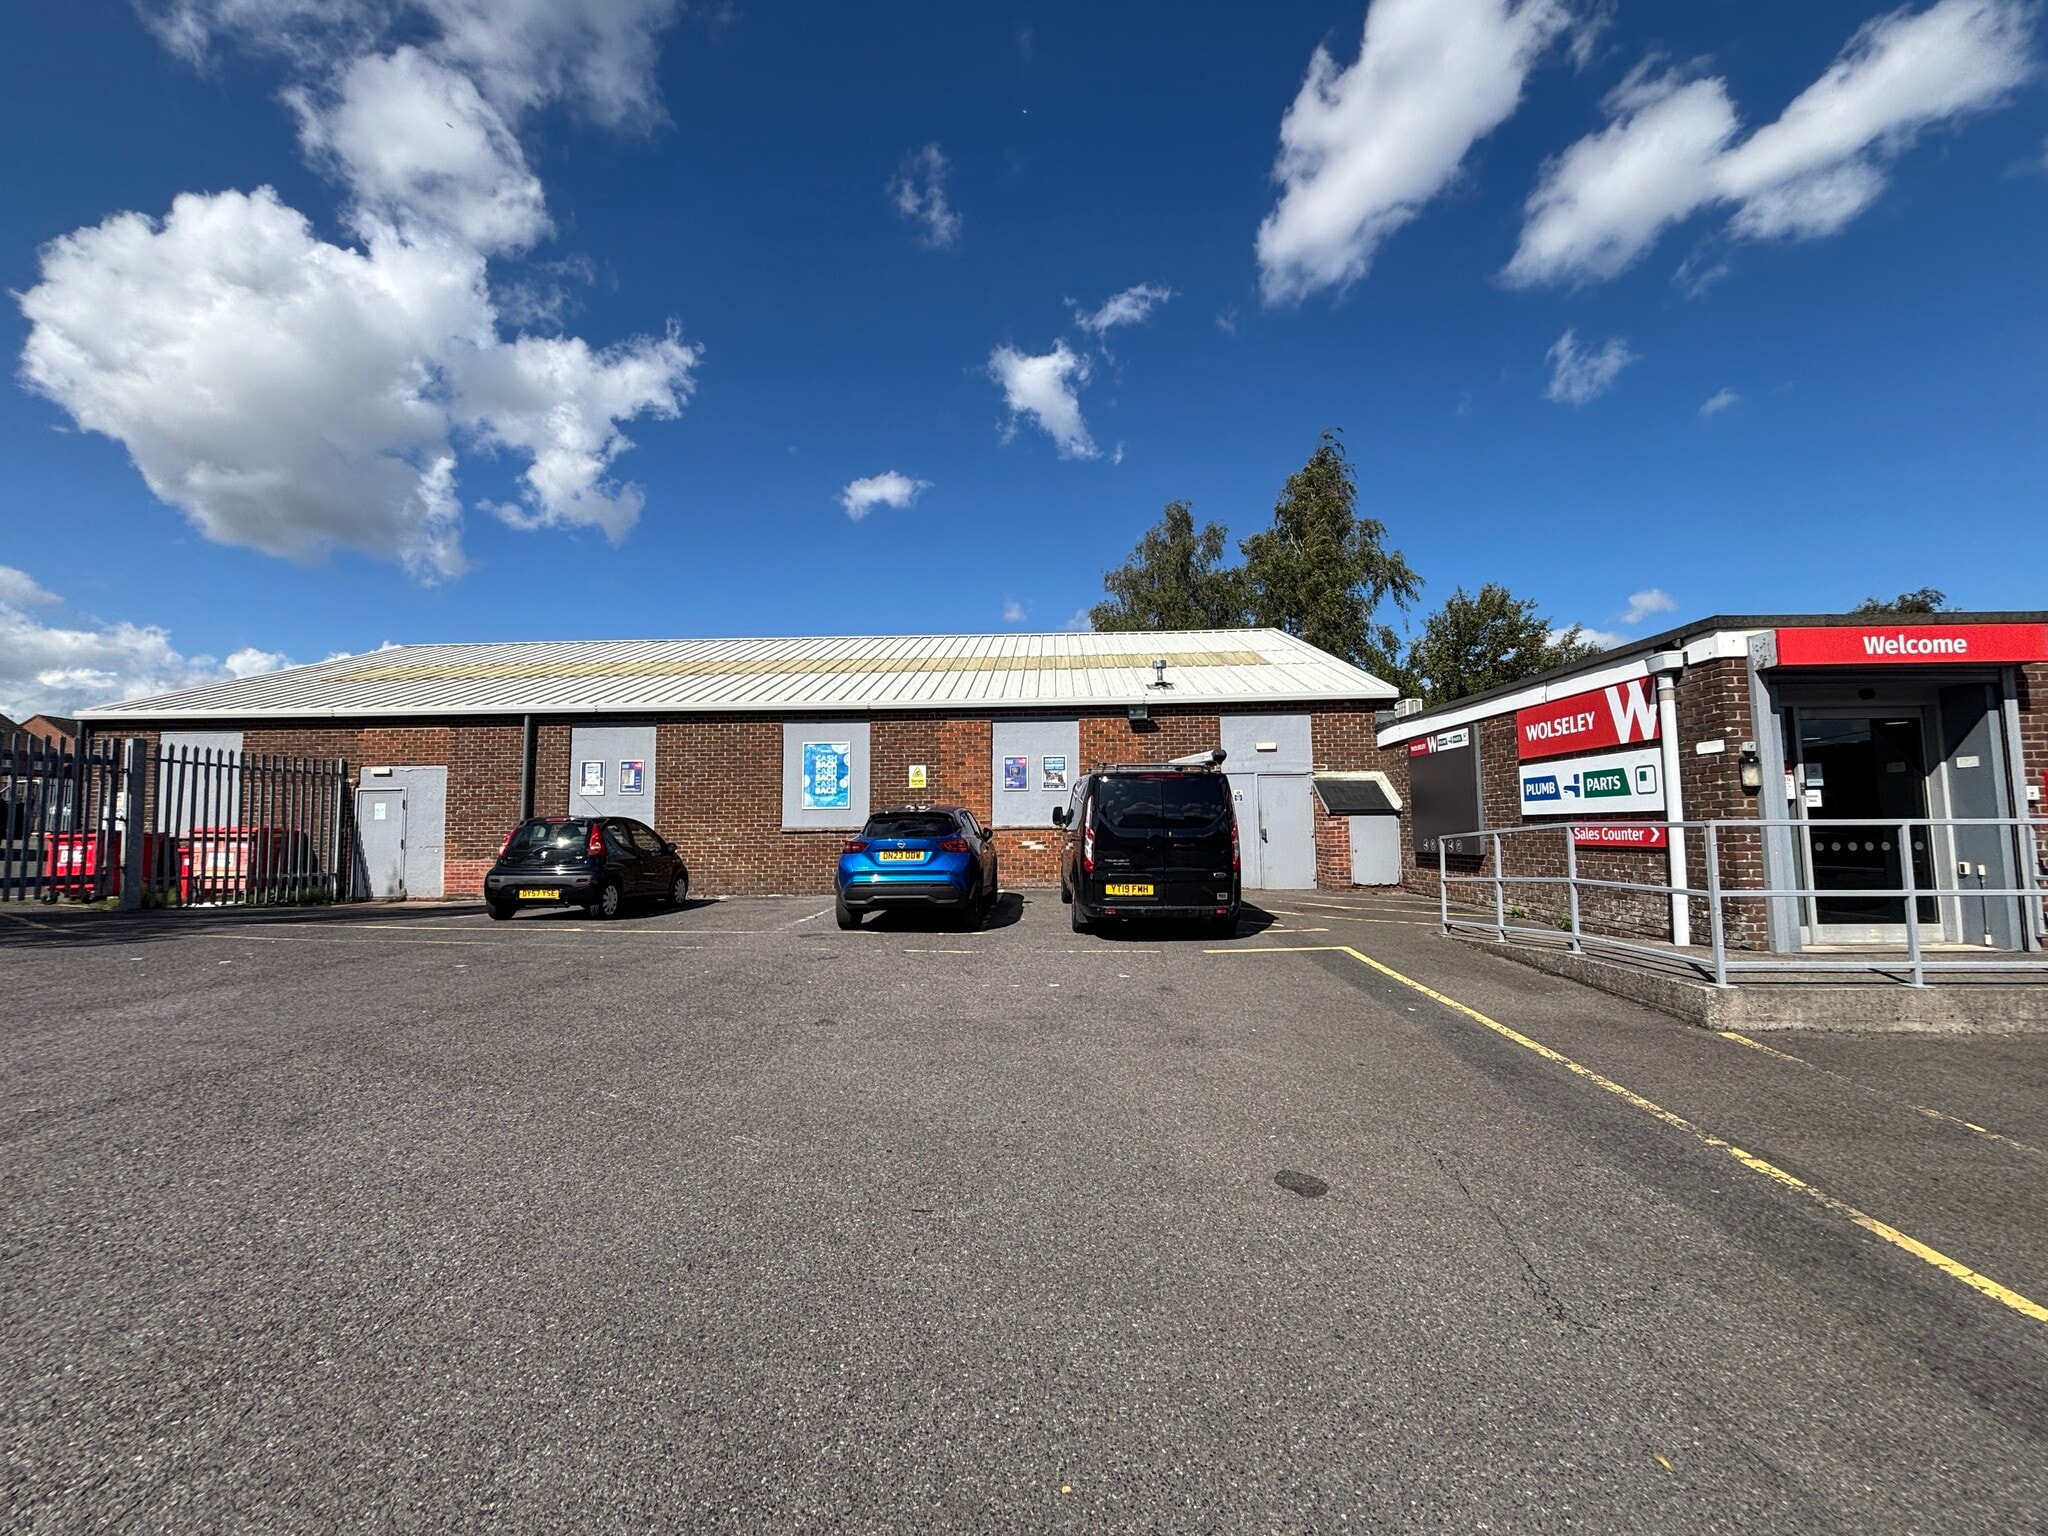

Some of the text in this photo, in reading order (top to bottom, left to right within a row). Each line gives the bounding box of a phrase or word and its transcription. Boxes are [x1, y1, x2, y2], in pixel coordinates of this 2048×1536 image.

[1863, 634, 1968, 655] Welcome
[1525, 680, 1658, 744] WOLSELEY W
[1426, 736, 1436, 754] W
[1526, 775, 1621, 796] PLUMB PARTS
[1574, 827, 1644, 841] Sales Counter
[883, 851, 903, 860] DN23
[1112, 885, 1130, 893] YT19
